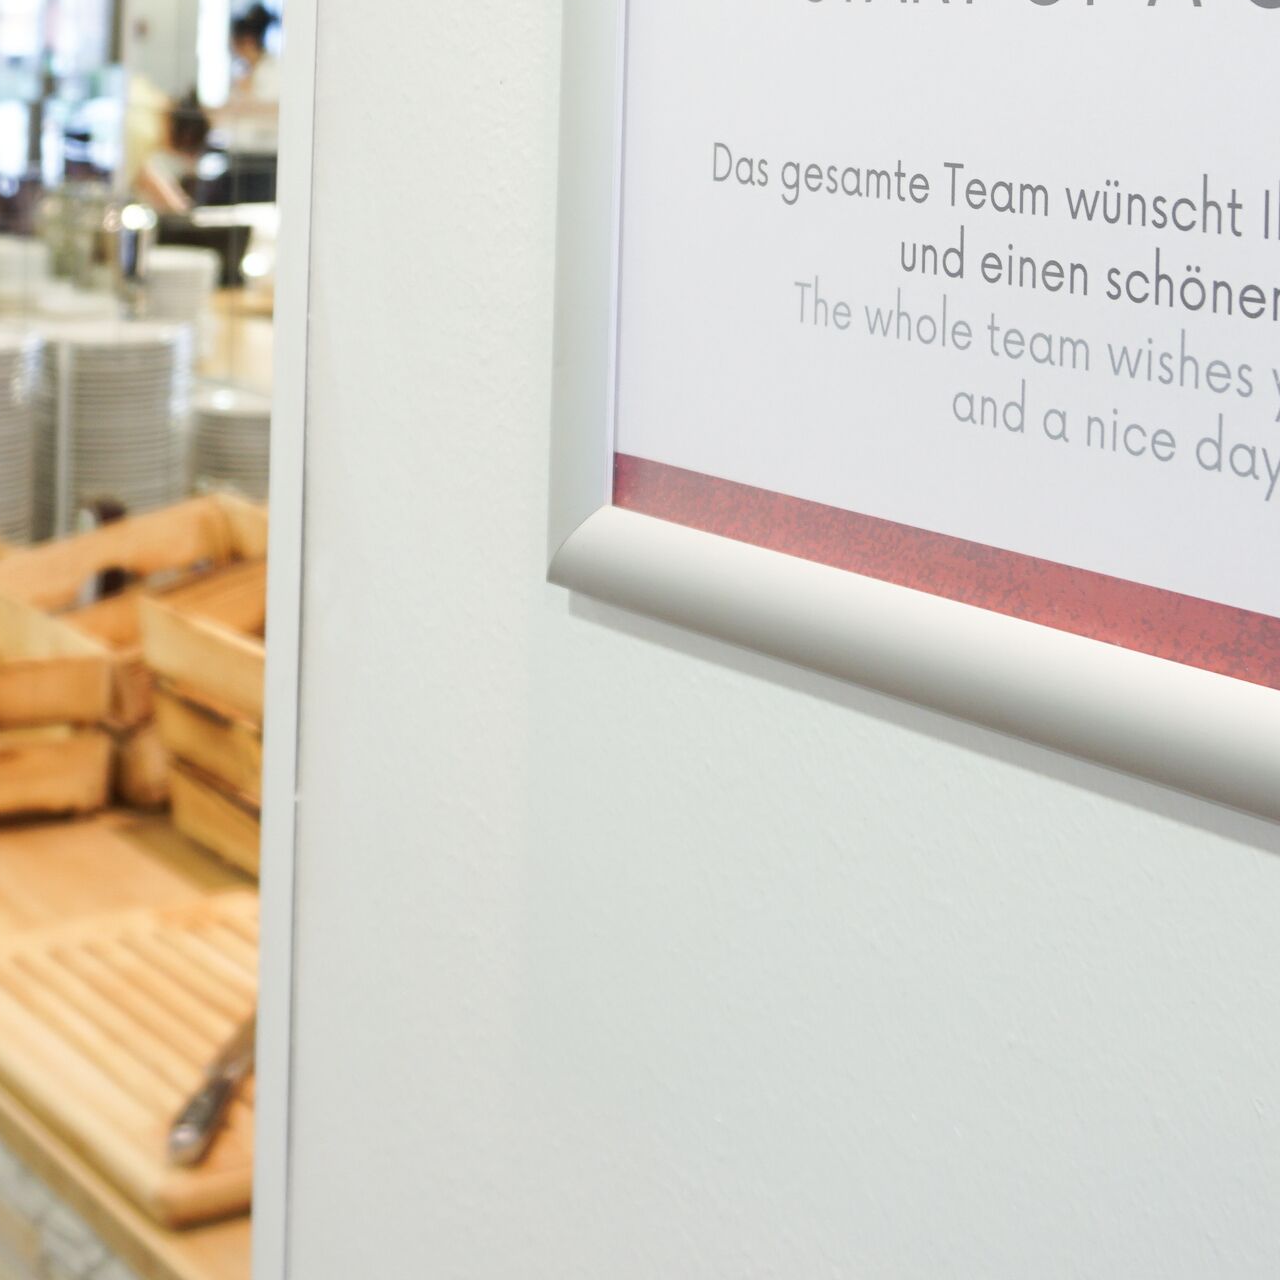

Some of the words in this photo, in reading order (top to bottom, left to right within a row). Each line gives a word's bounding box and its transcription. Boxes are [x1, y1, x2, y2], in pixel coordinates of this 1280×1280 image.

[713, 142, 769, 187] Das
[781, 160, 930, 205] gesamte
[944, 162, 1049, 217] Team
[1065, 174, 1243, 237] wünscht
[900, 225, 965, 279] und
[981, 250, 1088, 295] einen
[794, 275, 852, 330] The
[865, 287, 973, 350] whole
[987, 313, 1090, 371] team
[1107, 328, 1254, 398] wishes
[952, 379, 1026, 433] and
[1043, 409, 1069, 443] a
[1086, 408, 1176, 462] nice
